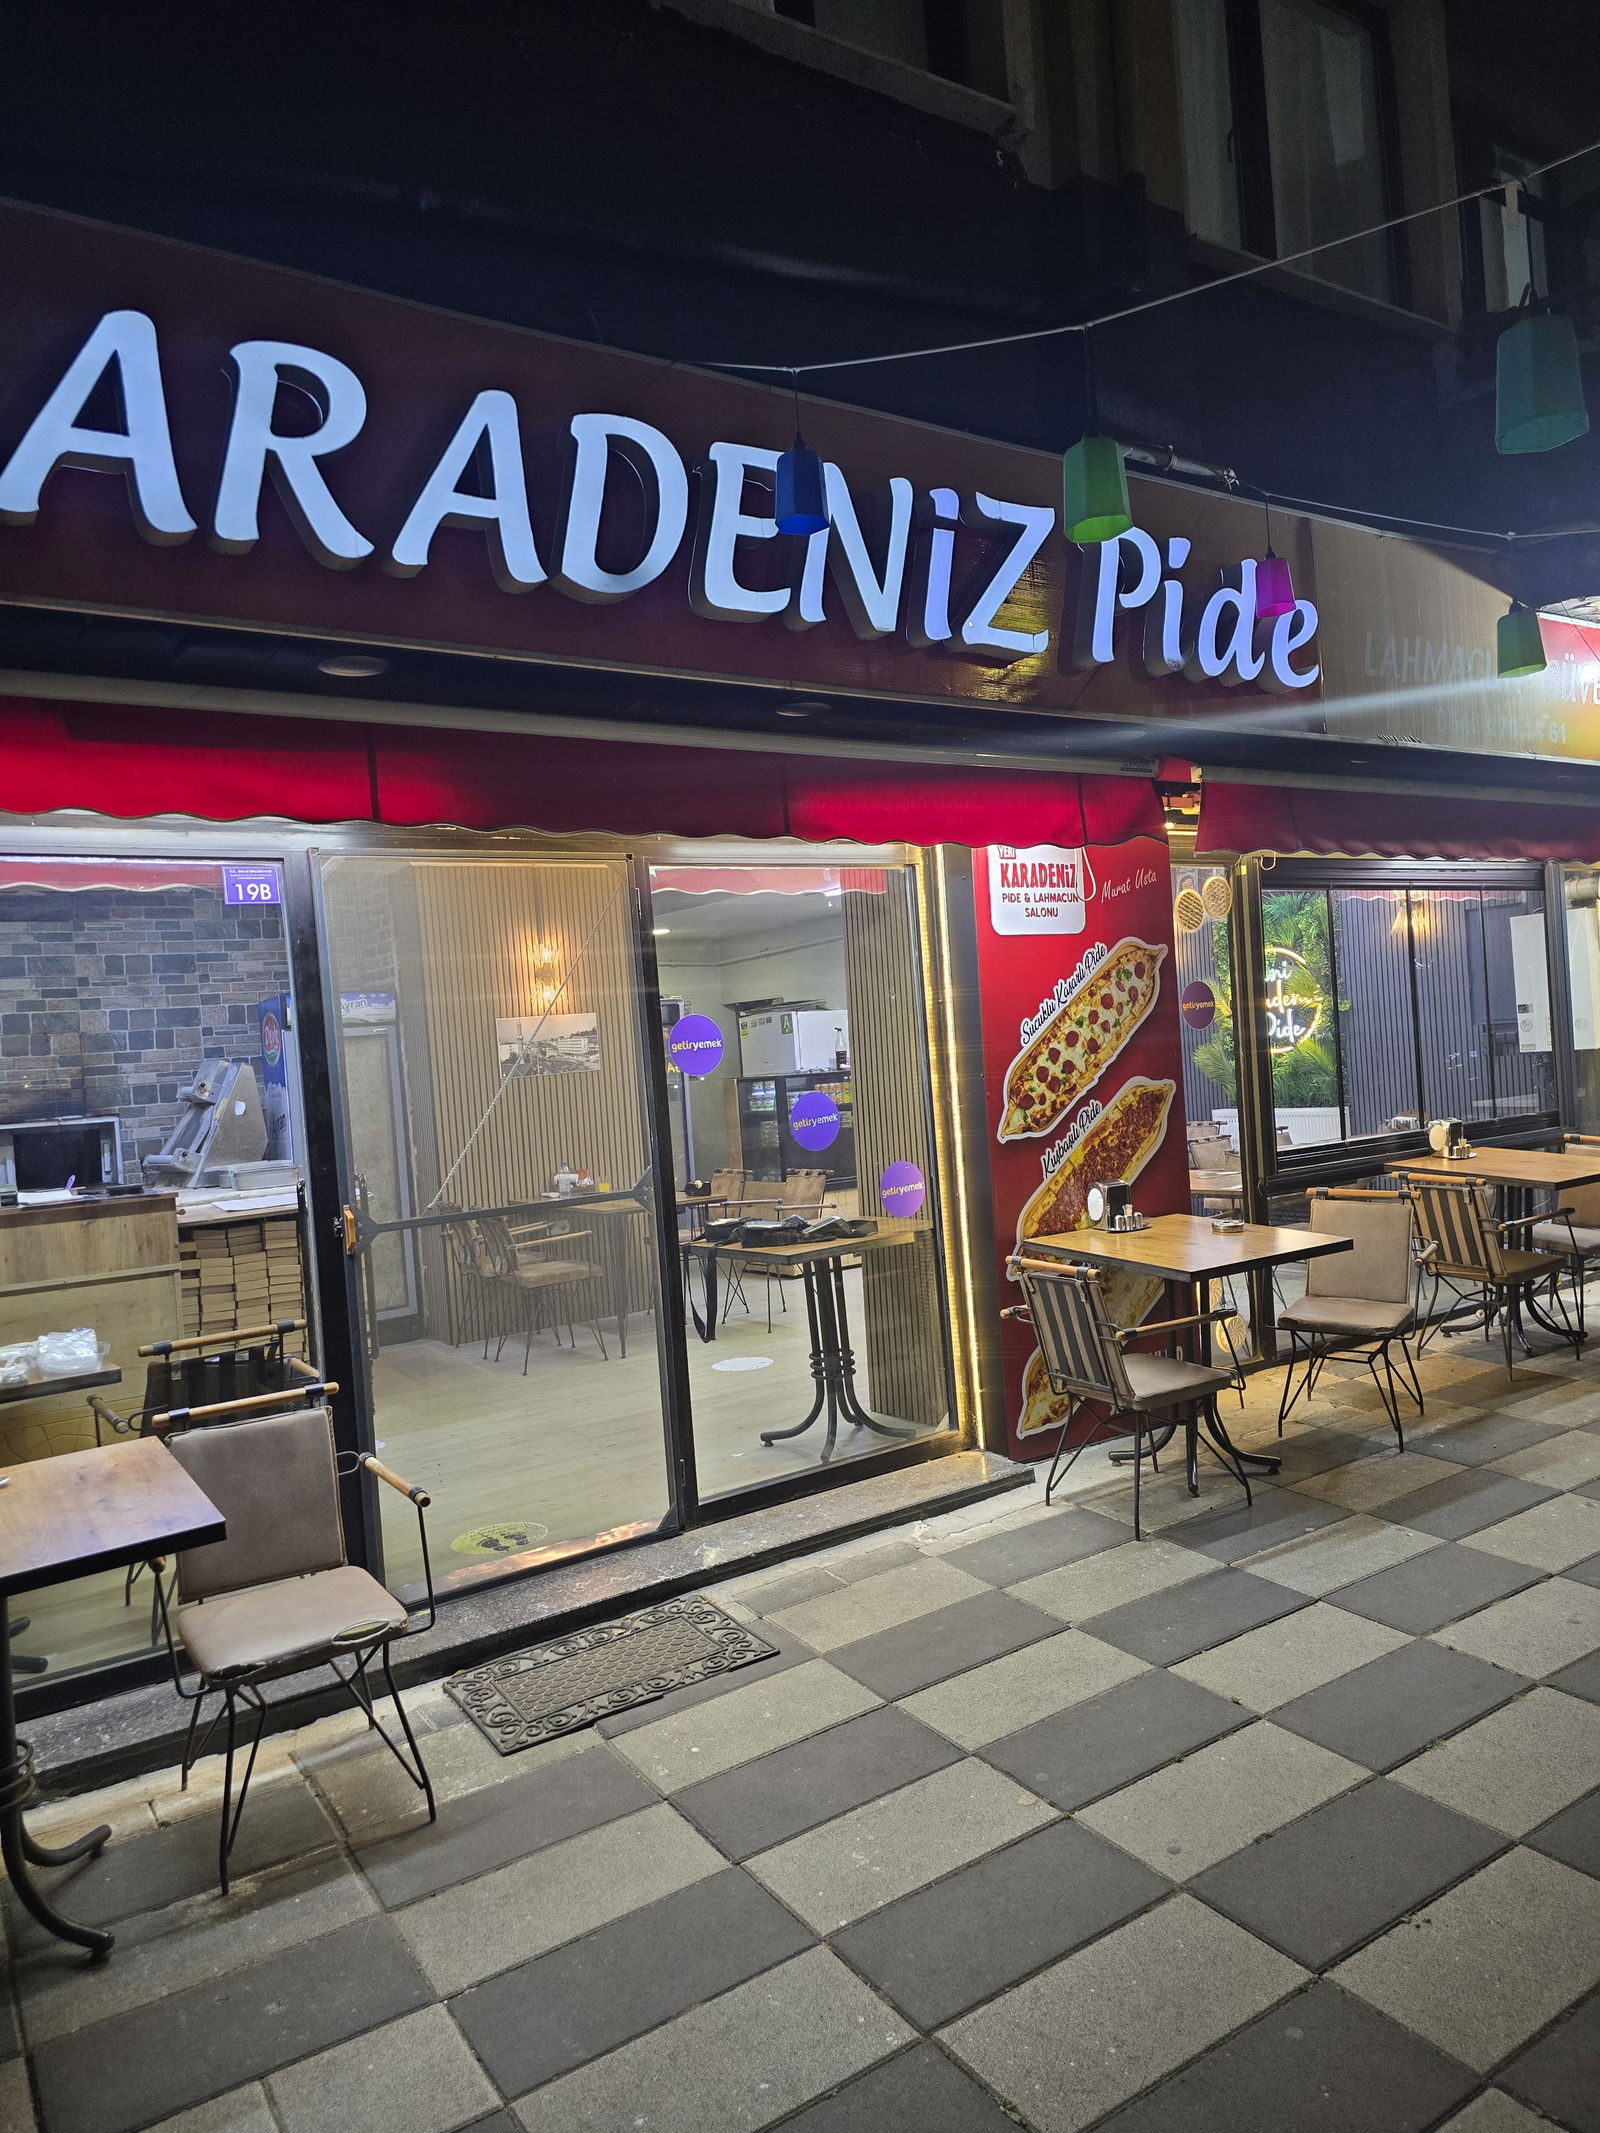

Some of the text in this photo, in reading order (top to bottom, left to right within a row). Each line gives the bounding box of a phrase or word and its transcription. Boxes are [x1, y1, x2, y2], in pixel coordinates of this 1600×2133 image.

[1092, 527, 1319, 688] Pide
[1548, 721, 1567, 744] 61
[1135, 868, 1157, 889] Usta
[235, 883, 272, 901] 19B
[1024, 892, 1031, 903] &
[1033, 892, 1079, 903] LAHMACUN
[1024, 907, 1059, 918] SALONU
[1022, 1000, 1056, 1045] Sucuklu
[1084, 944, 1106, 974] Pide
[1182, 1000, 1215, 1011] getiryemek
[671, 1038, 722, 1053] getiryemek
[792, 1112, 839, 1131] getiryemek
[1079, 1101, 1101, 1134] Pide
[881, 1180, 924, 1199] getiryemek
